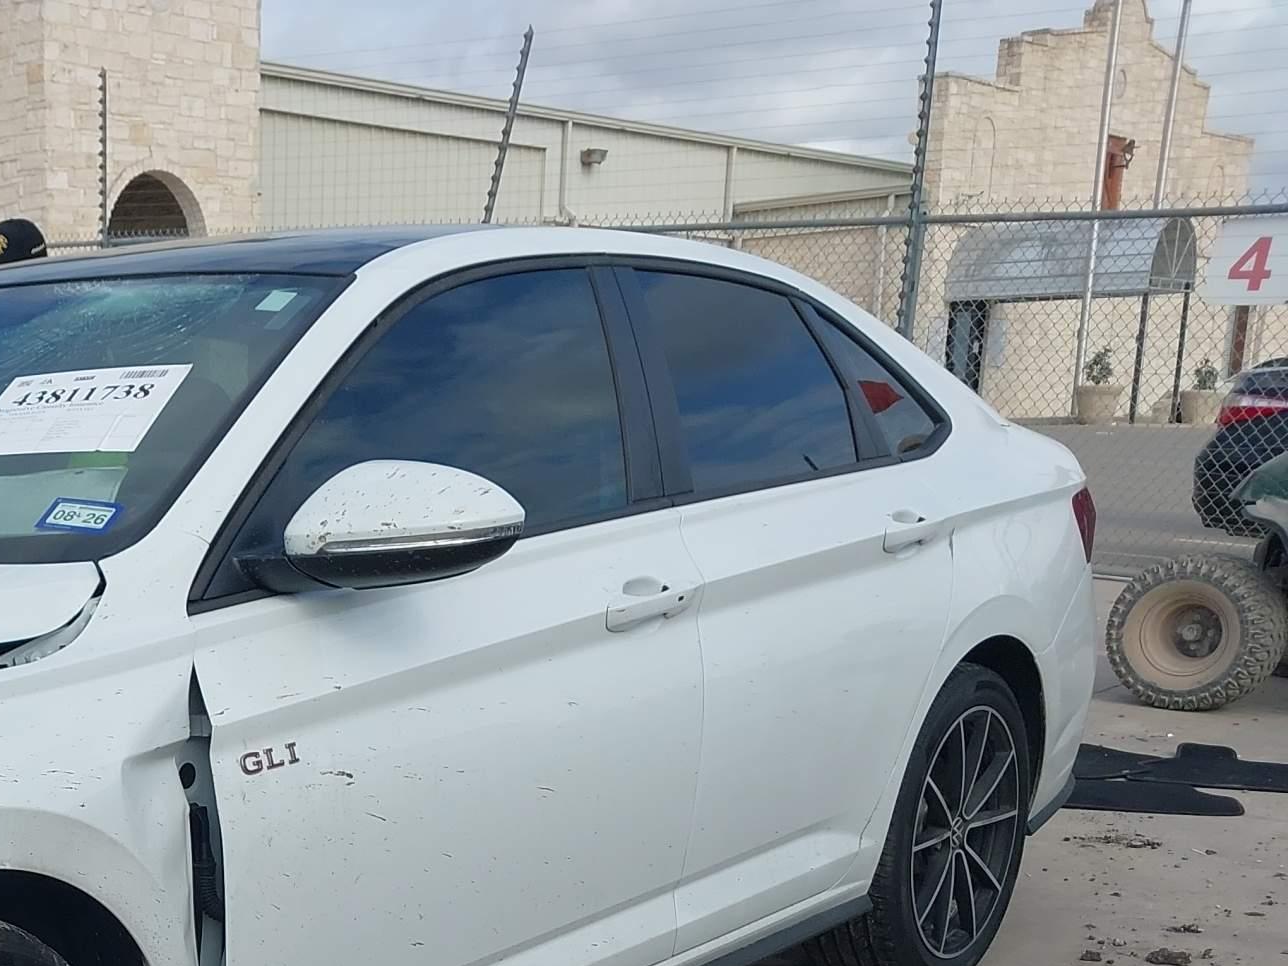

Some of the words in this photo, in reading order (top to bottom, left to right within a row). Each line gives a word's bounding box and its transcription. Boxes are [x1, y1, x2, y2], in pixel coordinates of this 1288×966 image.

[1227, 236, 1273, 291] 4
[12, 383, 155, 406] 43811738
[53, 509, 76, 522] 08
[81, 512, 108, 525] 26
[239, 742, 300, 775] GLI
